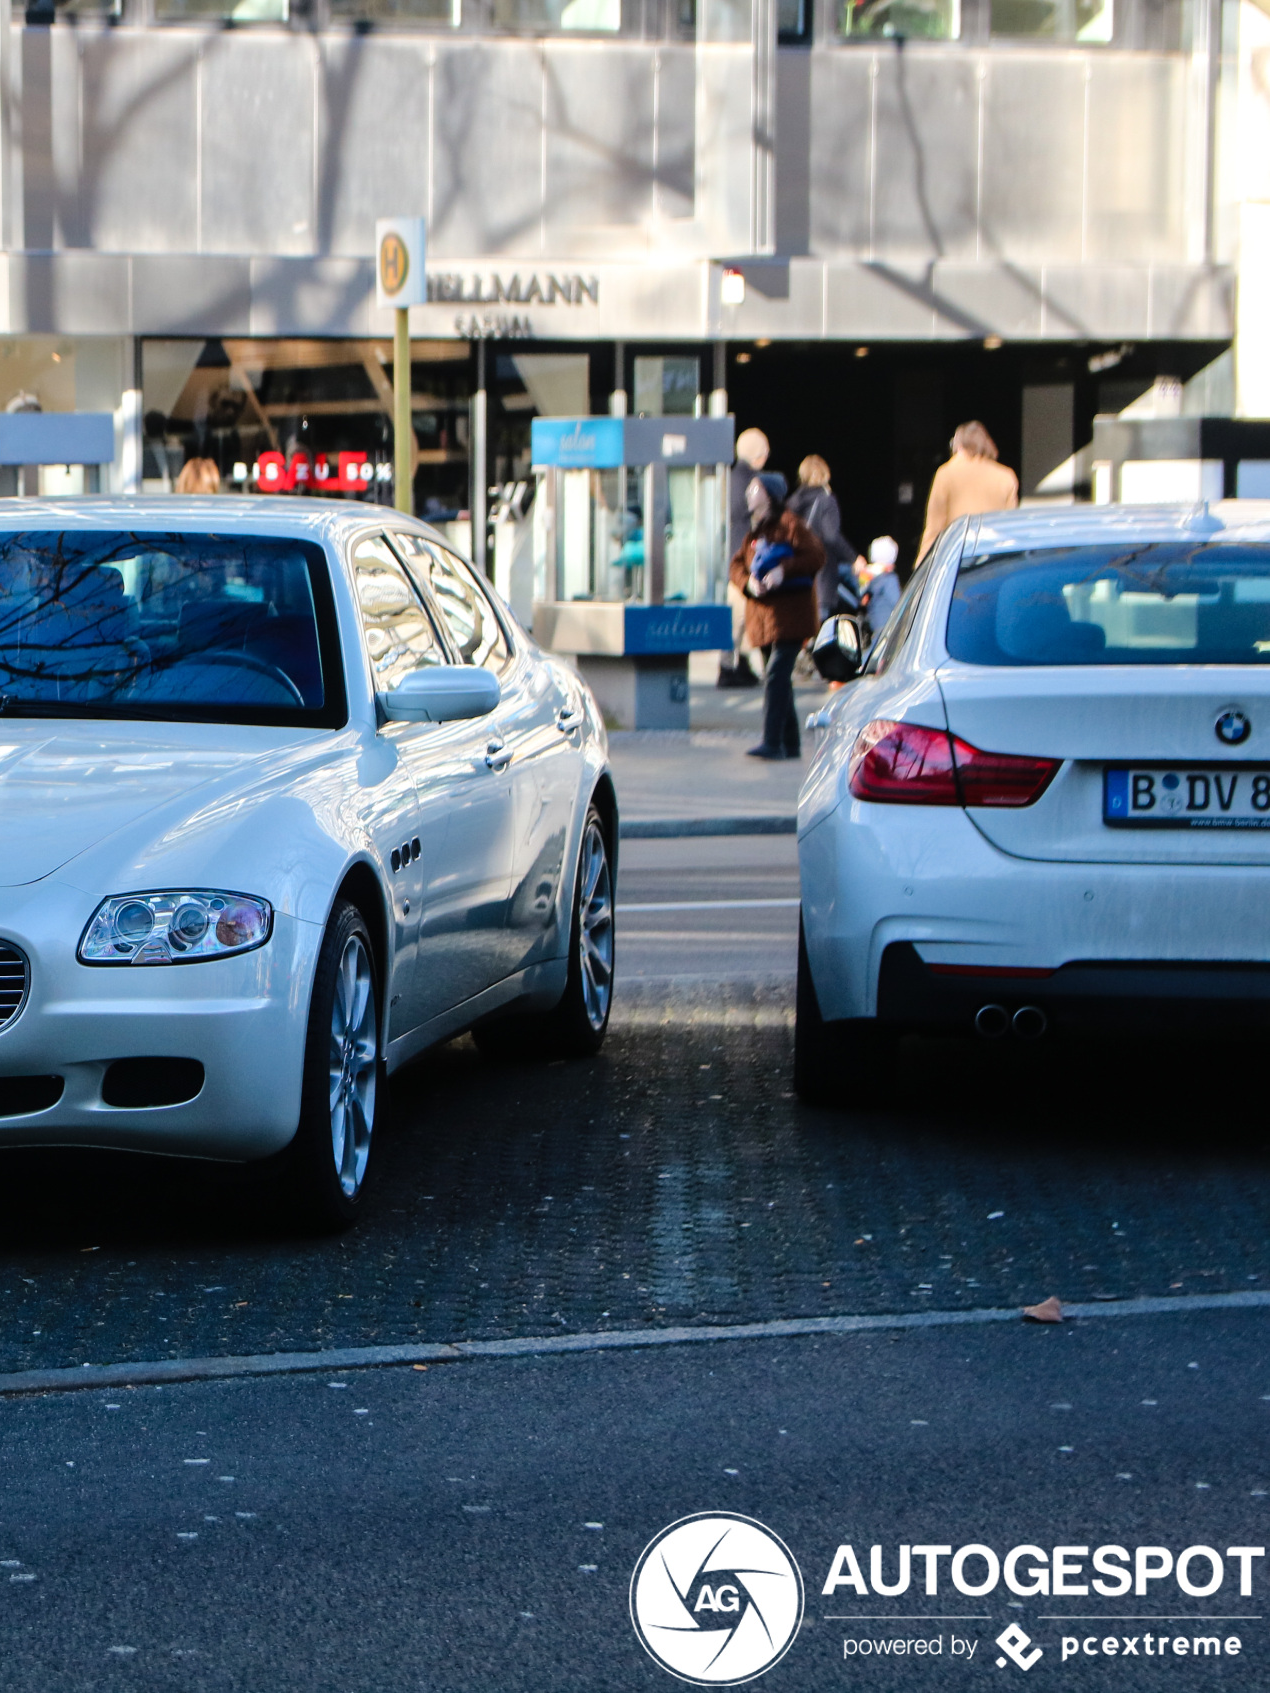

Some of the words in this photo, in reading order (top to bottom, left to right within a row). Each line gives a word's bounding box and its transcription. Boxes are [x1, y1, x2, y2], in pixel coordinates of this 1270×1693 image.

[384, 246, 399, 279] H
[233, 462, 279, 481] BIS
[346, 462, 393, 481] 50%
[257, 450, 368, 492] SALE
[1132, 774, 1157, 811] B
[1186, 774, 1239, 812] DV
